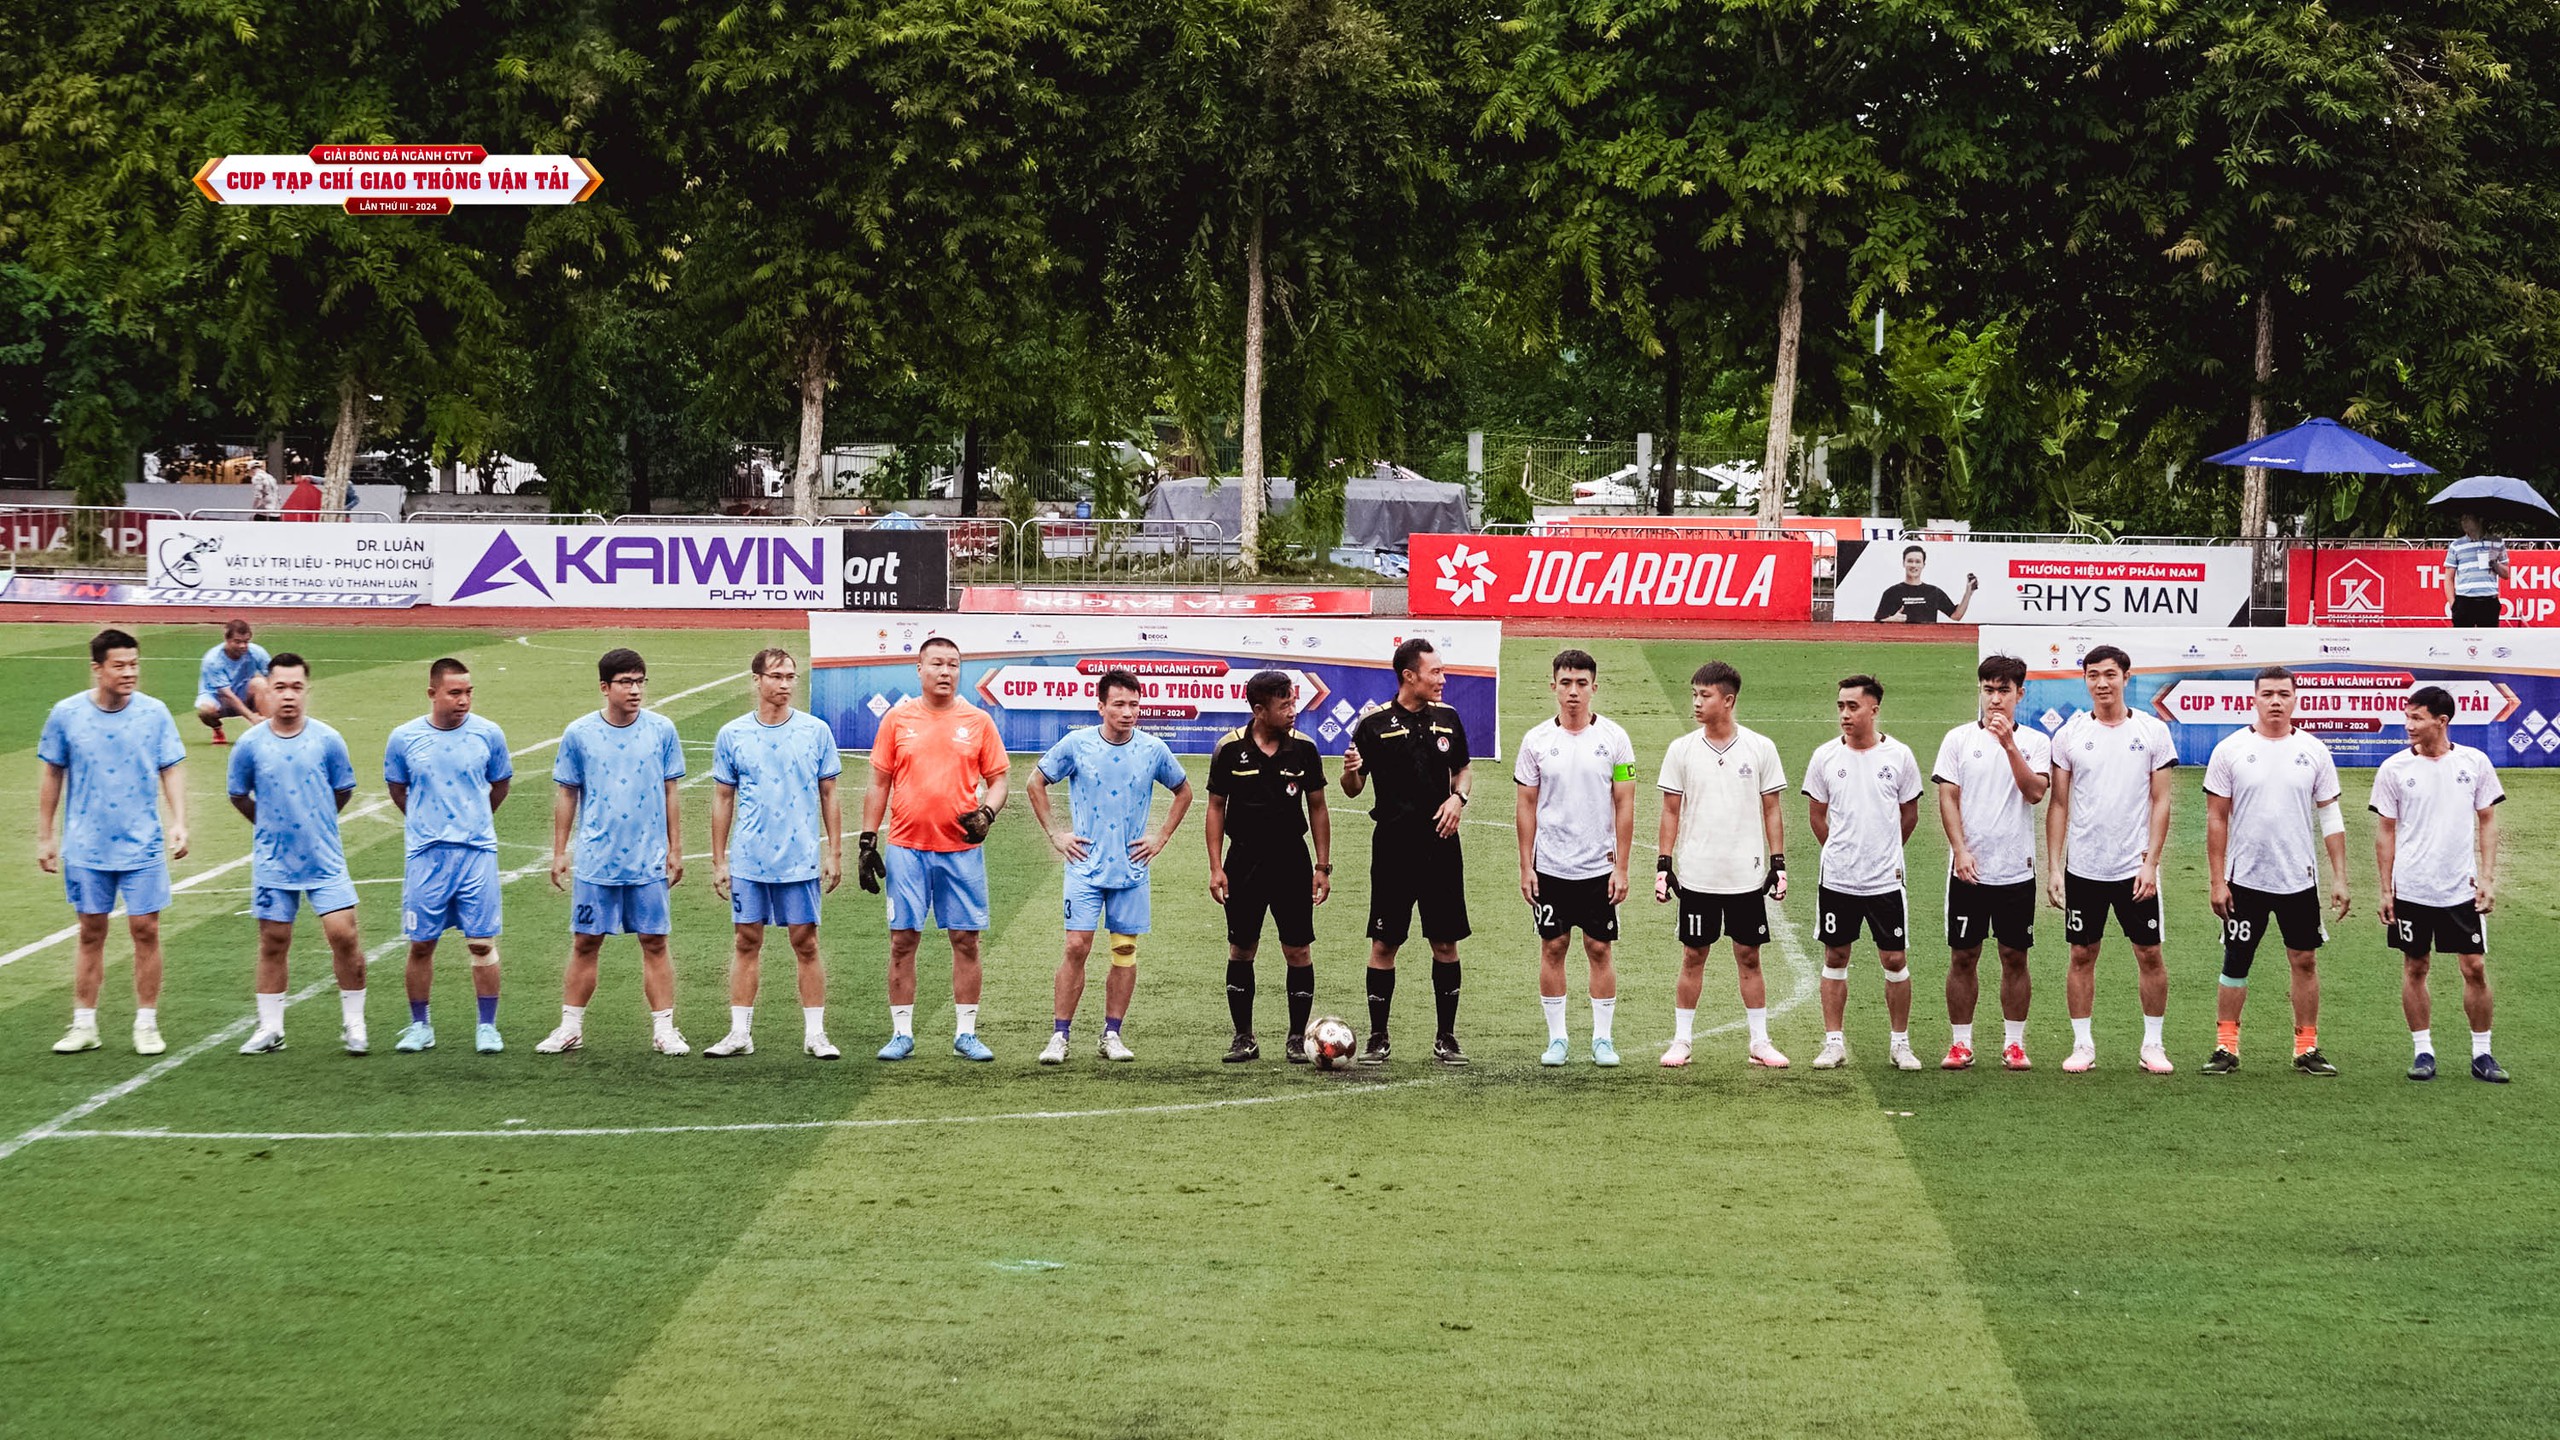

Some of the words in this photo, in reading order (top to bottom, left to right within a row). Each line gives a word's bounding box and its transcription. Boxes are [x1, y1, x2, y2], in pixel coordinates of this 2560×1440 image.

[357, 539, 380, 552] DR.
[384, 537, 424, 552] LUÂN
[225, 555, 249, 570] VẬT
[252, 555, 268, 568] LÝ
[271, 557, 291, 571] TRỊ
[294, 555, 323, 571] LIỆU
[334, 558, 372, 572] PHỤC
[402, 556, 433, 570] CHỨ
[555, 537, 824, 585] KAIWIN
[844, 552, 900, 585] ort
[2018, 563, 2071, 575] THƯƠNG
[2074, 564, 2104, 579] HIỆU
[2107, 564, 2126, 577] MỸ
[2169, 567, 2198, 578] NAM
[1508, 550, 1777, 608] JOGARBOLA
[710, 589, 759, 601] PLAY
[763, 590, 788, 601] TO
[793, 590, 824, 601] WIN
[845, 591, 898, 606] EEPING
[1183, 600, 1256, 610] BIA
[2017, 583, 2112, 613] RHYS
[2124, 586, 2198, 614] MAN
[1138, 663, 1153, 675] ĐÁ
[1152, 664, 1190, 675] NGÀNH
[1192, 665, 1218, 675] GTVT
[1003, 680, 1038, 697] CUP
[1043, 680, 1079, 700] TẠP
[1165, 679, 1224, 699] THÔNG
[2296, 675, 2317, 687] ÓNG
[2320, 675, 2336, 687] ĐÁ
[2337, 675, 2374, 687] NGÀNH
[2375, 677, 2402, 687] GTVT
[2180, 695, 2215, 711] CUP
[2300, 695, 2341, 712] GIAO
[2349, 691, 2409, 712] THÔNG
[2458, 689, 2489, 712] TẢI
[1153, 708, 1161, 717] III
[1167, 709, 1186, 718] 2024
[2317, 719, 2335, 730] THỨ
[2335, 721, 2343, 729] III
[2349, 722, 2369, 730] 2024
[577, 904, 595, 925] 22
[1534, 903, 1555, 926] 92
[1688, 914, 1701, 936] 11
[1825, 912, 1836, 934] 8
[1957, 916, 1968, 938] 7
[2397, 918, 2414, 942] 13
